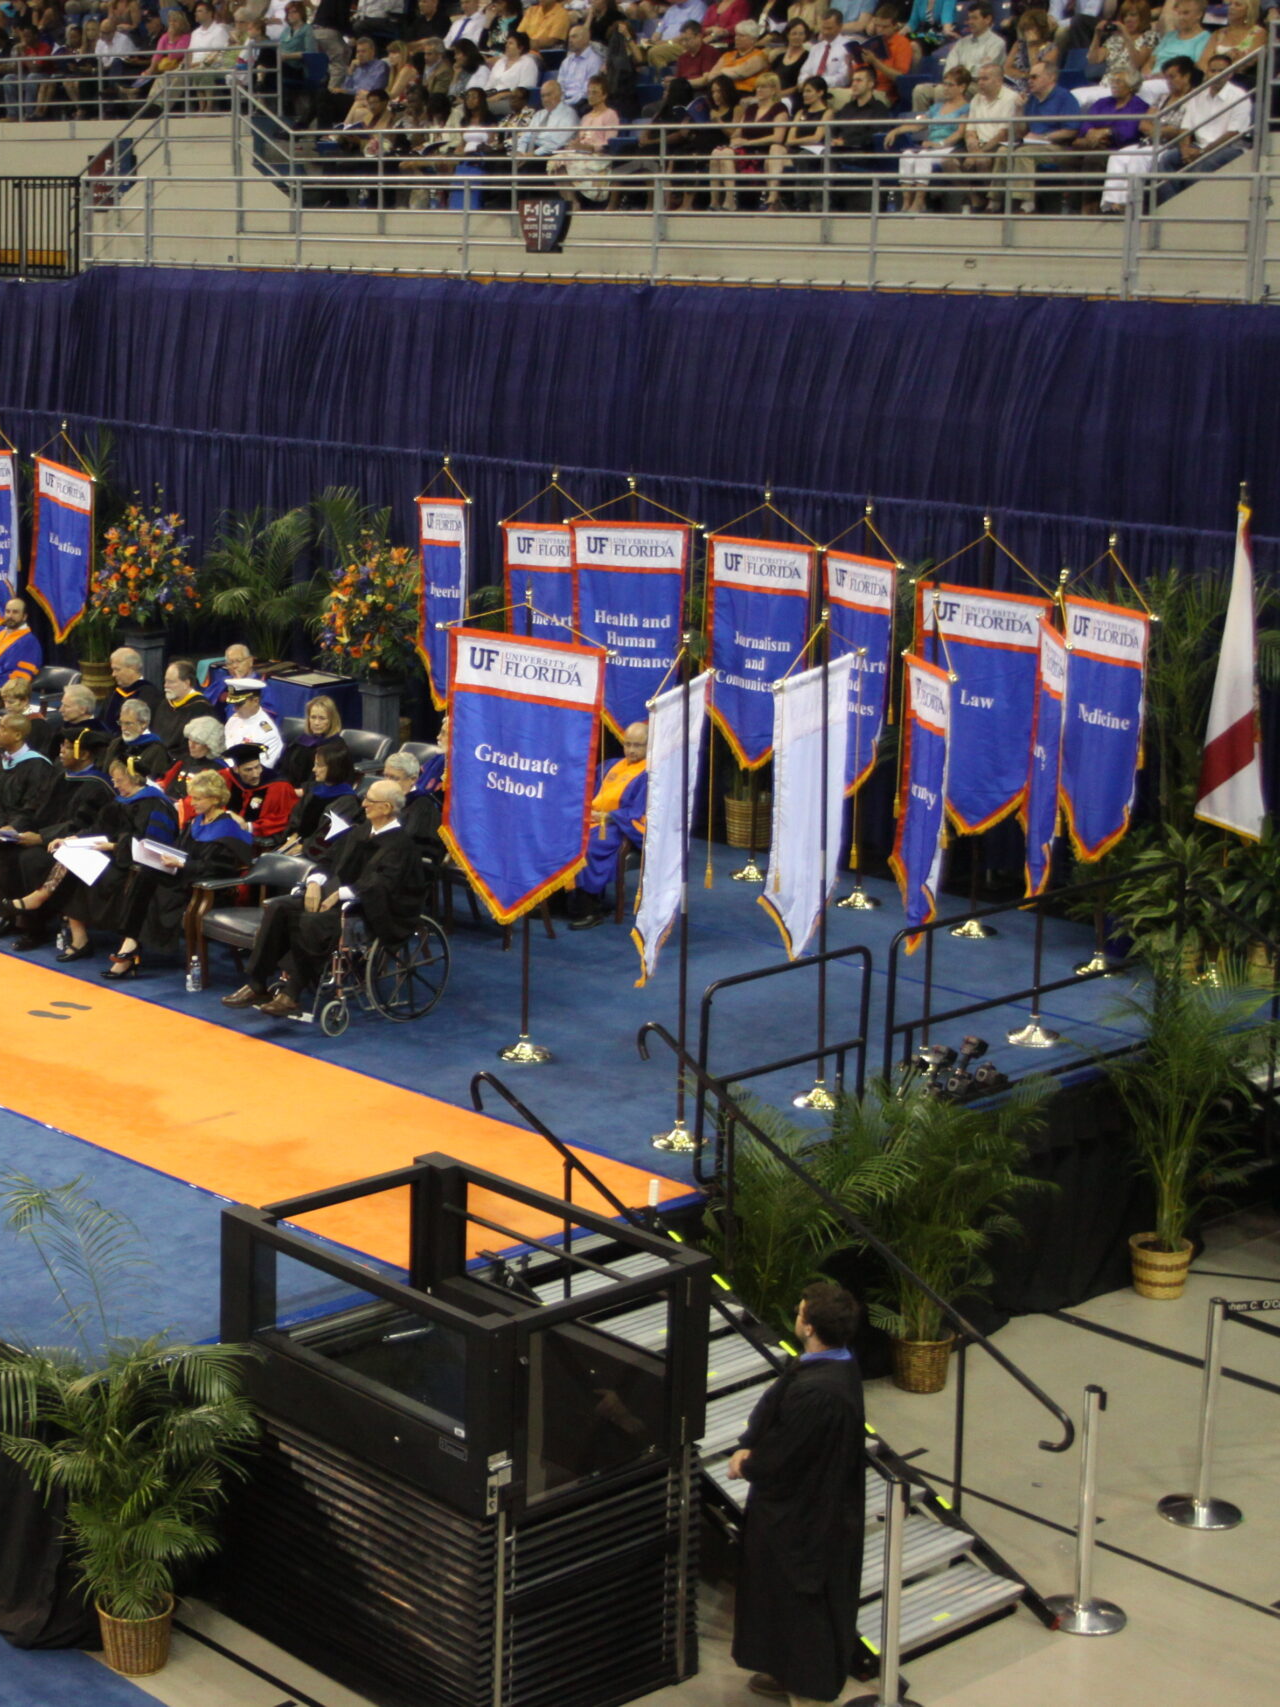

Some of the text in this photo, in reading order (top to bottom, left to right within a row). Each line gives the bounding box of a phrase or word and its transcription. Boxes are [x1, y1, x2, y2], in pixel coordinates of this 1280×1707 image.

[524, 204, 539, 216] F-1
[542, 204, 560, 216] G-1
[517, 537, 535, 554] UF
[539, 544, 570, 556] FLORI
[586, 537, 608, 554] UF
[614, 544, 675, 558] FLORIDA
[724, 552, 743, 572] UF
[747, 562, 802, 580] FLORIDA
[835, 567, 847, 588] UF
[850, 577, 888, 597] FLORIDA
[594, 609, 671, 628] Health and
[936, 600, 960, 622] UF
[965, 605, 1019, 618] UNIVERSITY
[965, 613, 1033, 635] FLORIDA
[1074, 615, 1091, 637] UF
[606, 631, 657, 648] Human
[1093, 627, 1139, 649] FLORIDA
[470, 646, 499, 671] UF
[505, 652, 578, 671] UNIVERSITY of
[744, 656, 765, 671] and
[504, 661, 582, 687] FLORIDA
[960, 689, 995, 710] Law
[474, 743, 559, 776] Graduate
[486, 771, 544, 799] School
